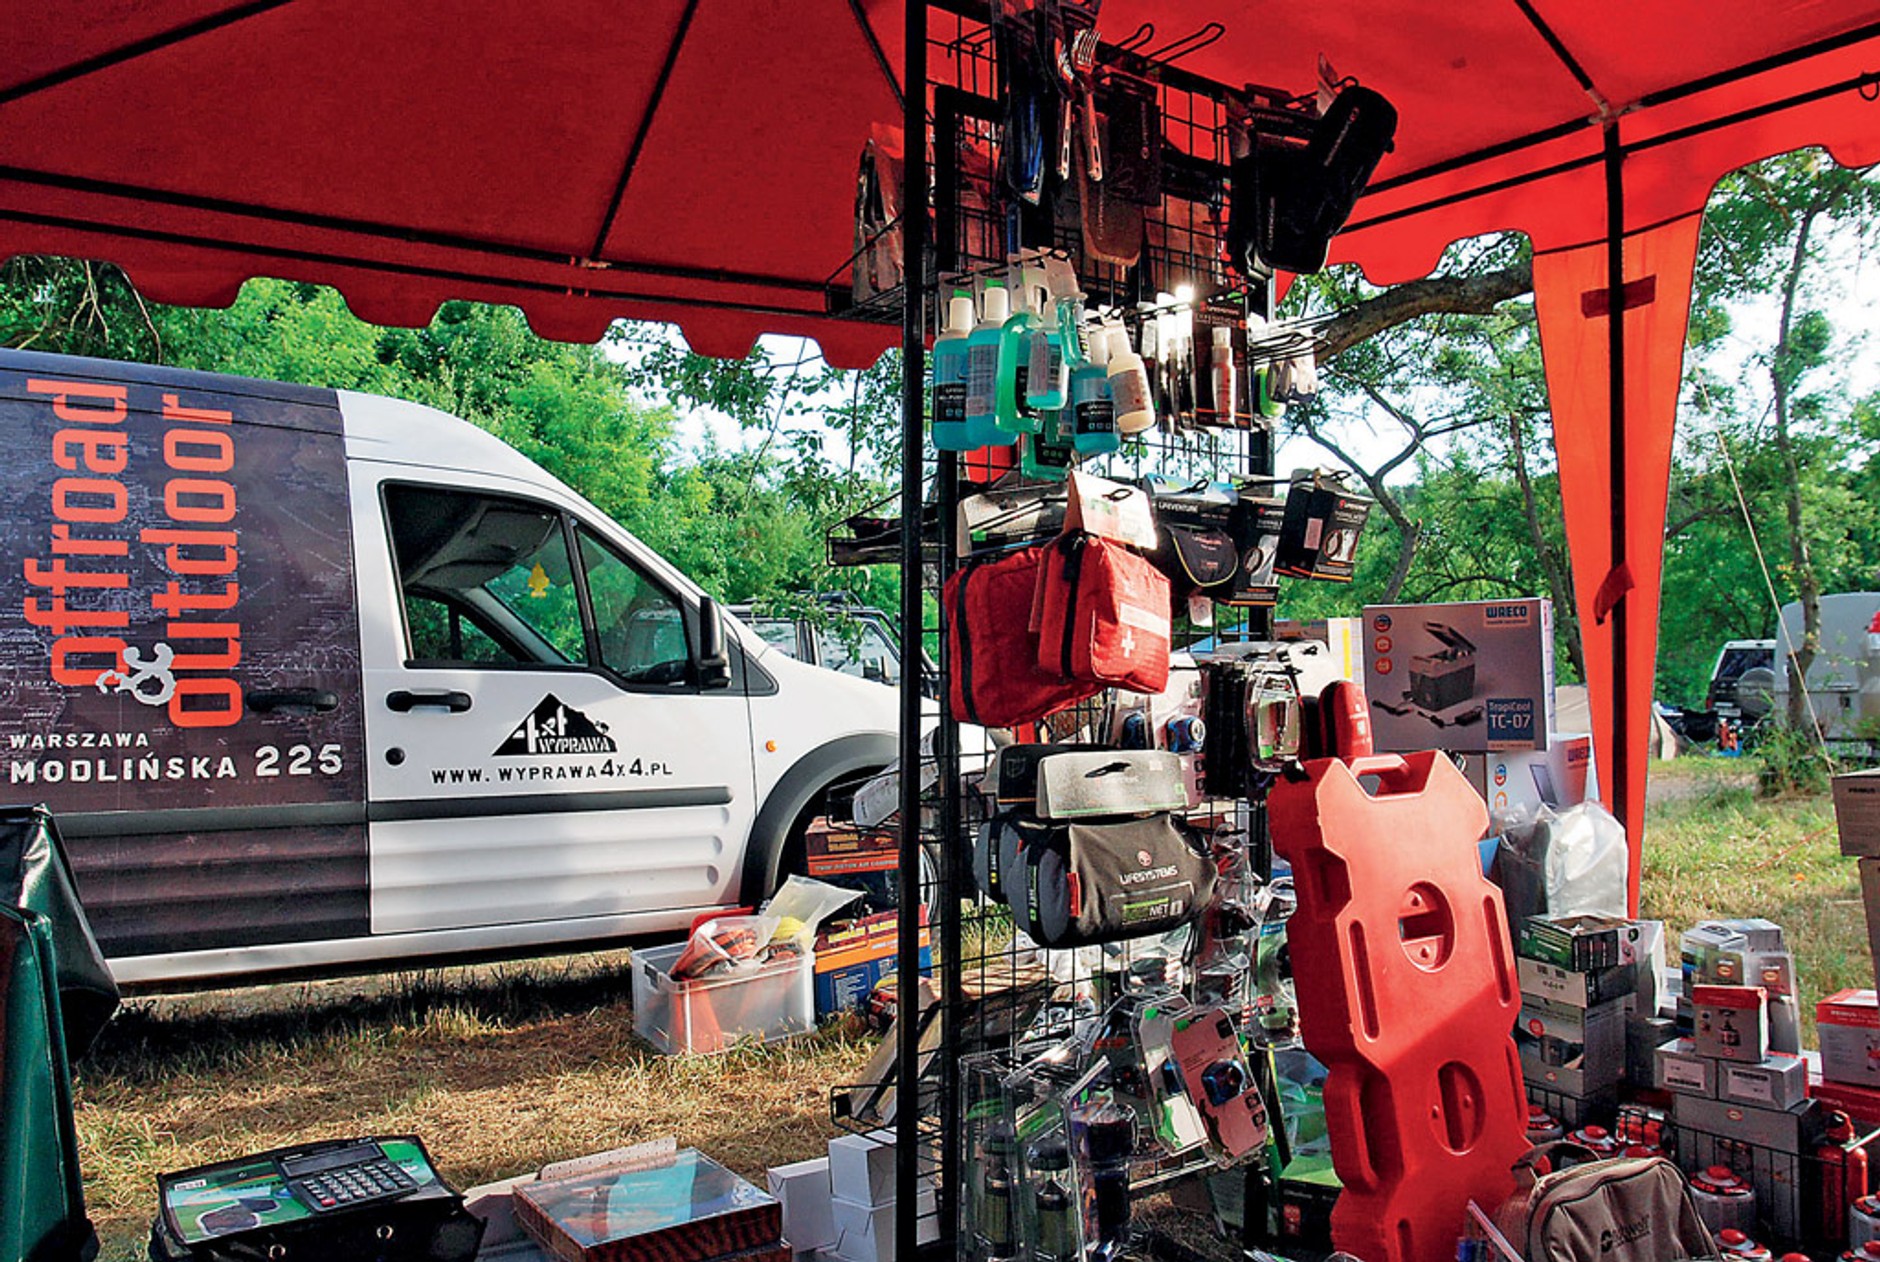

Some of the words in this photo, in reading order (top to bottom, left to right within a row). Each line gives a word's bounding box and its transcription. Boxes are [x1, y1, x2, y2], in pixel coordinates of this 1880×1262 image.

[24, 378, 130, 687] offroad
[140, 393, 244, 728] outdoor
[1490, 714, 1531, 729] TC-07
[9, 732, 149, 749] WARSZAWA
[538, 737, 611, 753] WYPRAWA
[10, 751, 237, 784] MODLIŃSKA
[255, 743, 343, 777] 225
